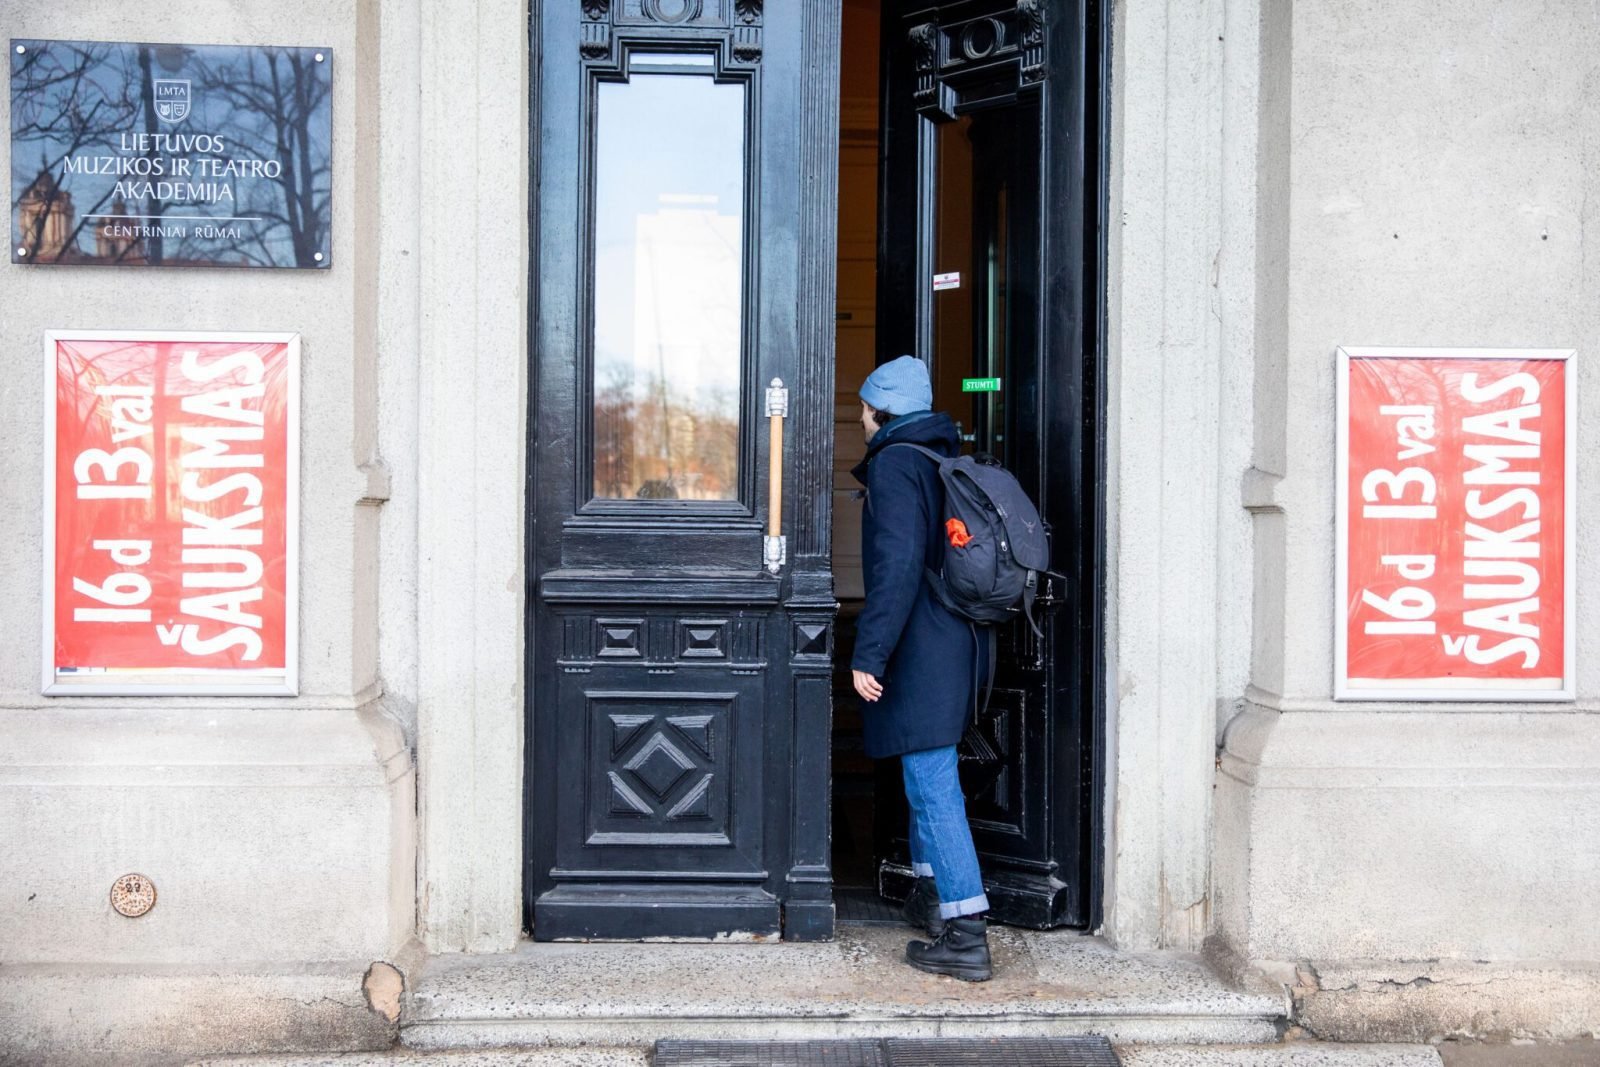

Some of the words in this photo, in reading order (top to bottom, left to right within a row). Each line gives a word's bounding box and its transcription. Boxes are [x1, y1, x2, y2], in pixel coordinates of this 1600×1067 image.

[158, 86, 186, 97] LMTA
[120, 133, 225, 153] LIETUVOS
[63, 156, 164, 177] MUZIKOS
[171, 157, 192, 177] IR
[196, 159, 281, 179] TEATRO
[111, 181, 235, 205] AKADEMIJA
[103, 225, 187, 238] CENTRINIAI
[195, 225, 241, 239] RŪMAI
[966, 381, 993, 389] STUMTI
[155, 349, 266, 662] ŠAUKSMAS
[1441, 371, 1542, 669] ŠAUKSMAS
